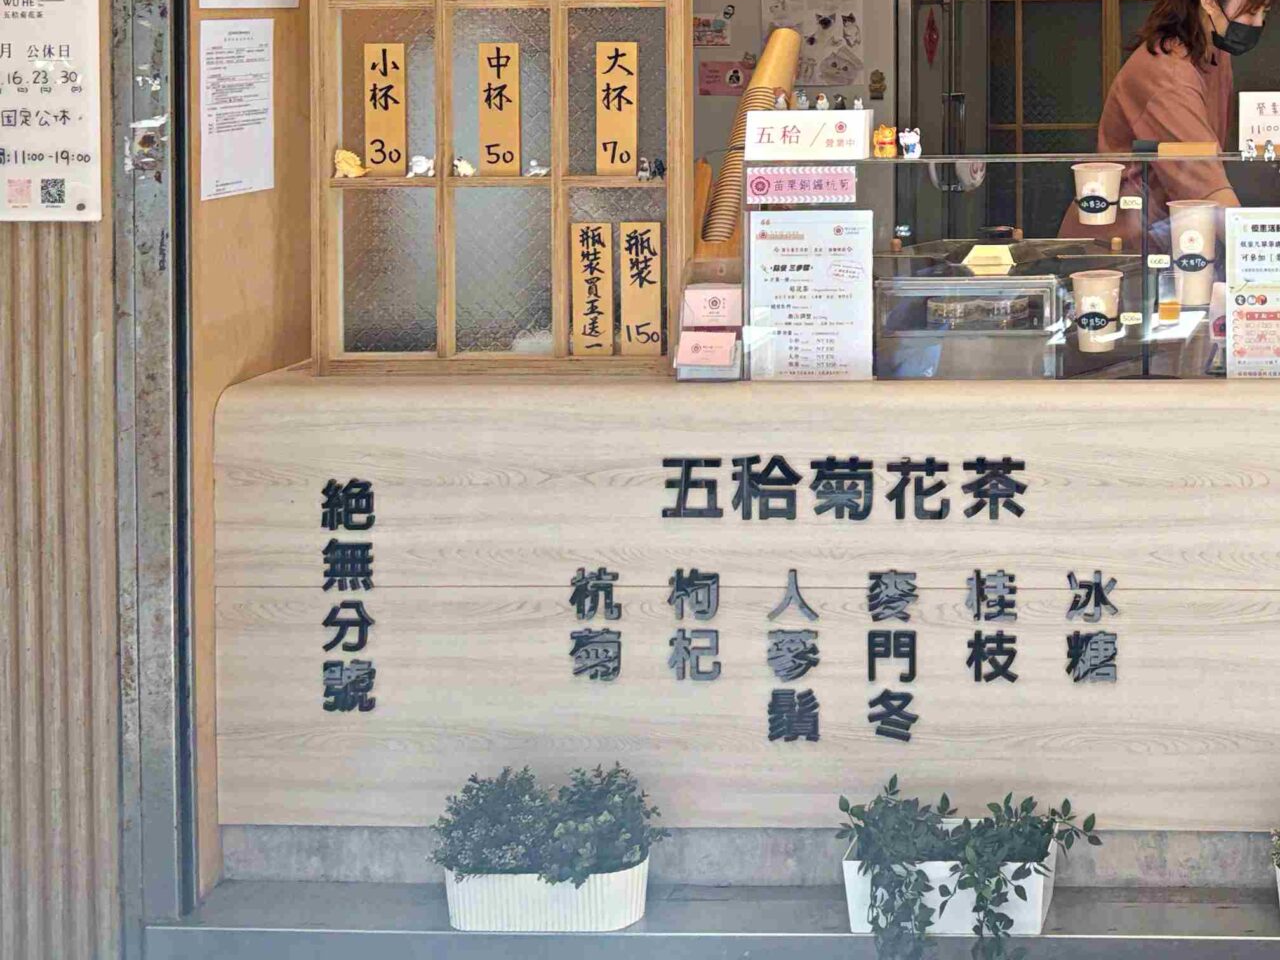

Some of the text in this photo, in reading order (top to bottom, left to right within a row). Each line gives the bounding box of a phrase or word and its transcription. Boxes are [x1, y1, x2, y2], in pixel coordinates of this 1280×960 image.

[27, 44, 70, 58] 公休日
[369, 47, 400, 111] 小杯
[483, 46, 513, 111] 中杯
[601, 47, 634, 112] 大杯
[370, 139, 400, 165] 30
[485, 143, 514, 164] 50
[602, 141, 631, 165] 70
[624, 228, 658, 288] 瓶裝
[626, 322, 660, 343] 150
[321, 477, 376, 713] 絕無分號
[568, 566, 622, 682] 杭菊
[667, 567, 722, 681] 枸杞
[965, 568, 1019, 683] 桂枝
[1065, 569, 1119, 683] 冰糖
[867, 568, 919, 743] 麥門冬
